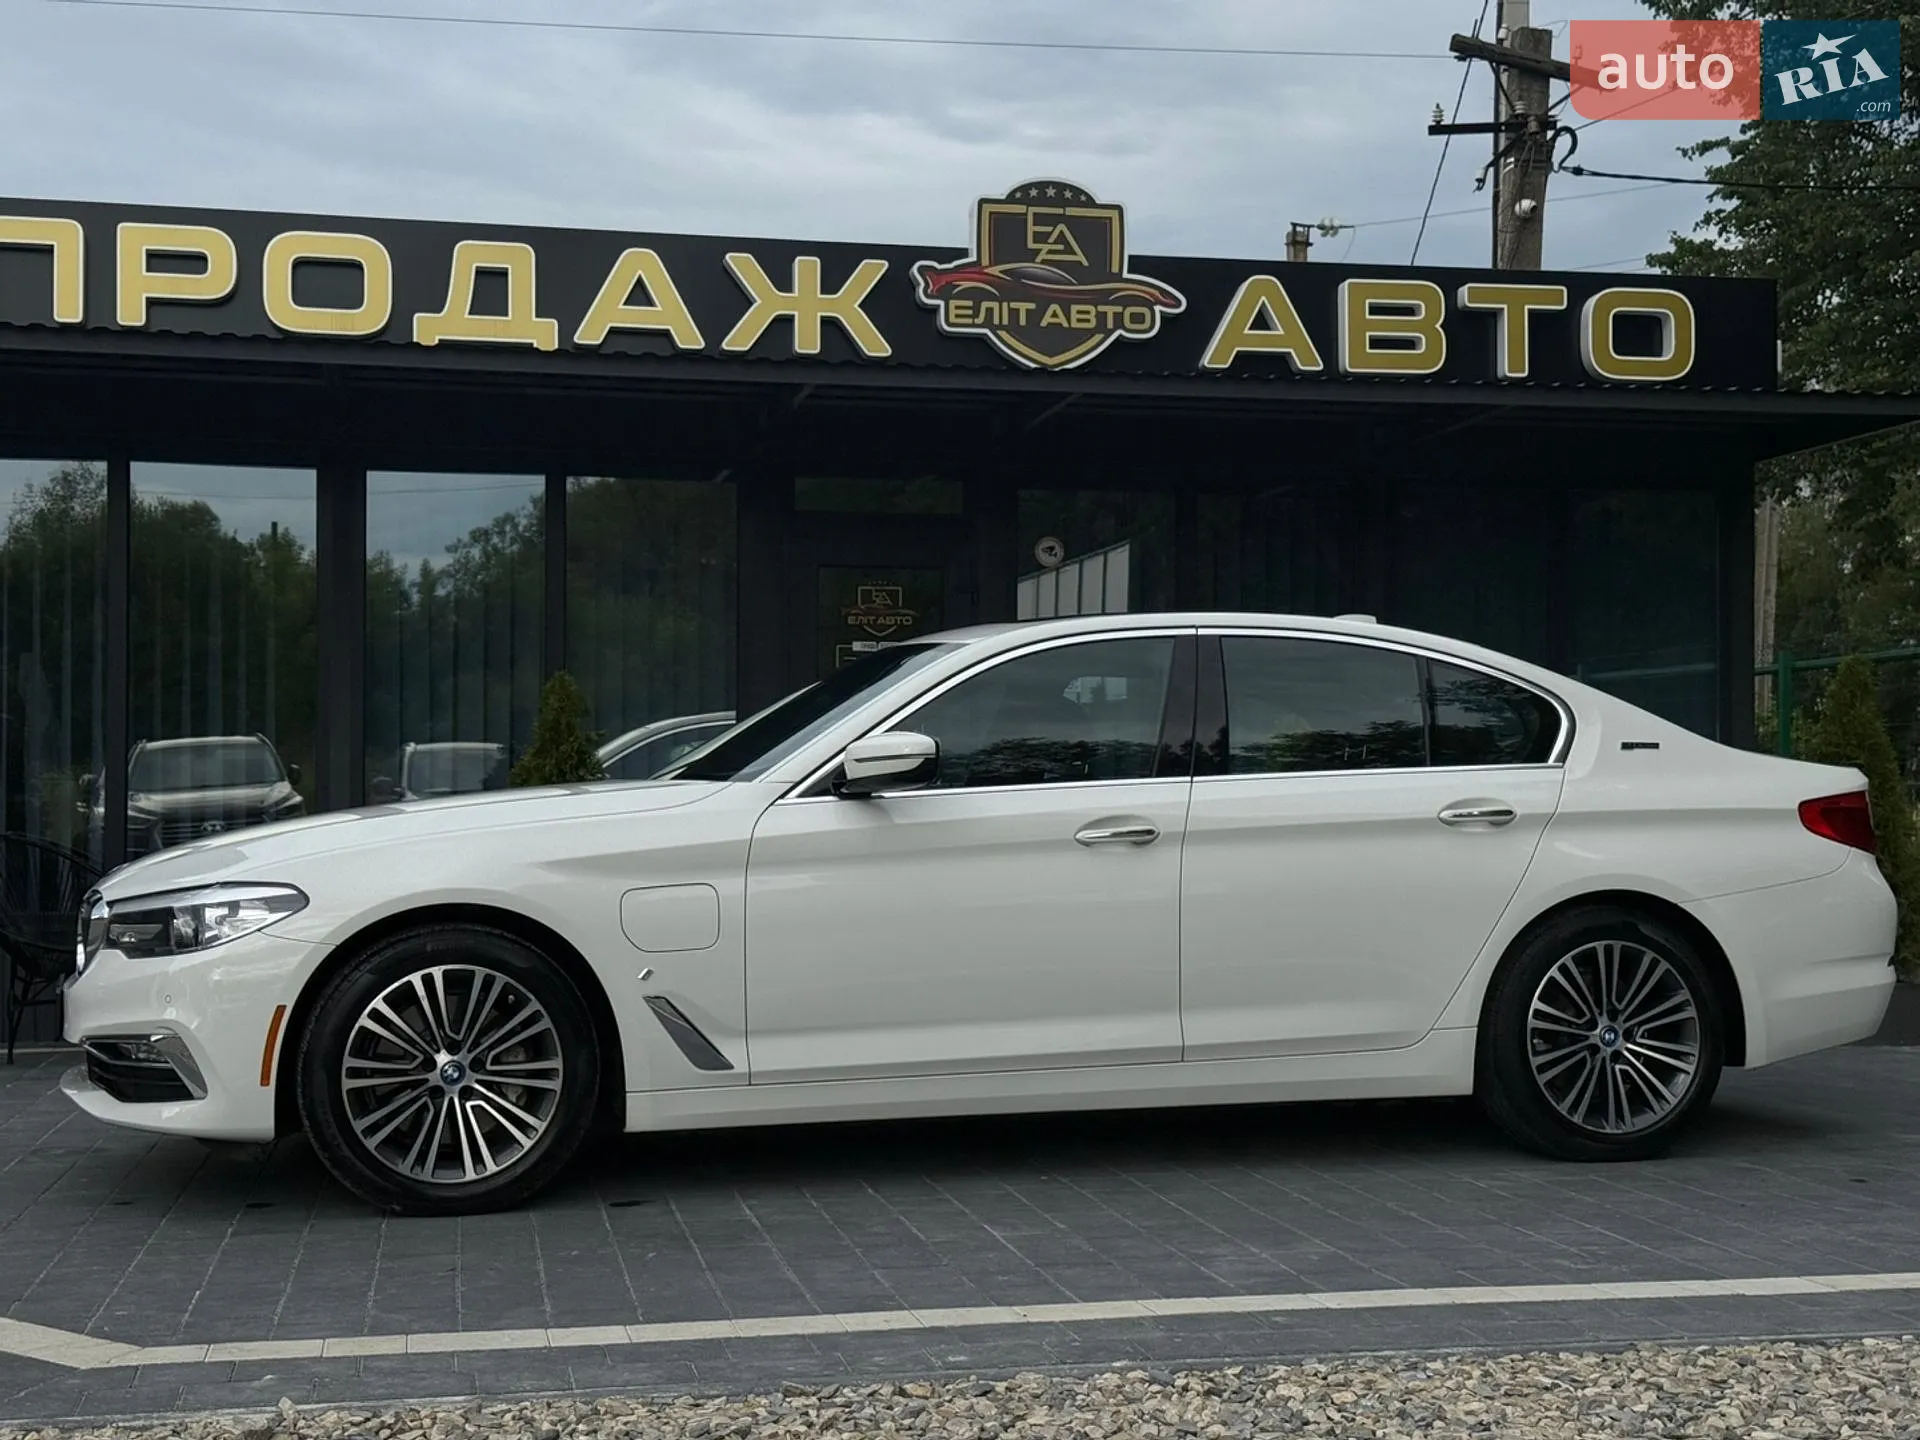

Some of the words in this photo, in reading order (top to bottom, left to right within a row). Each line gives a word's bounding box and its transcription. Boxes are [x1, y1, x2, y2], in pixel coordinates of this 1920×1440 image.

[0, 215, 892, 358] ПРОДАЖ
[1201, 274, 1696, 380] АВТО
[949, 299, 1036, 327] ЕЛІТ
[1040, 304, 1152, 330] АВТО
[877, 615, 913, 625] АВТО
